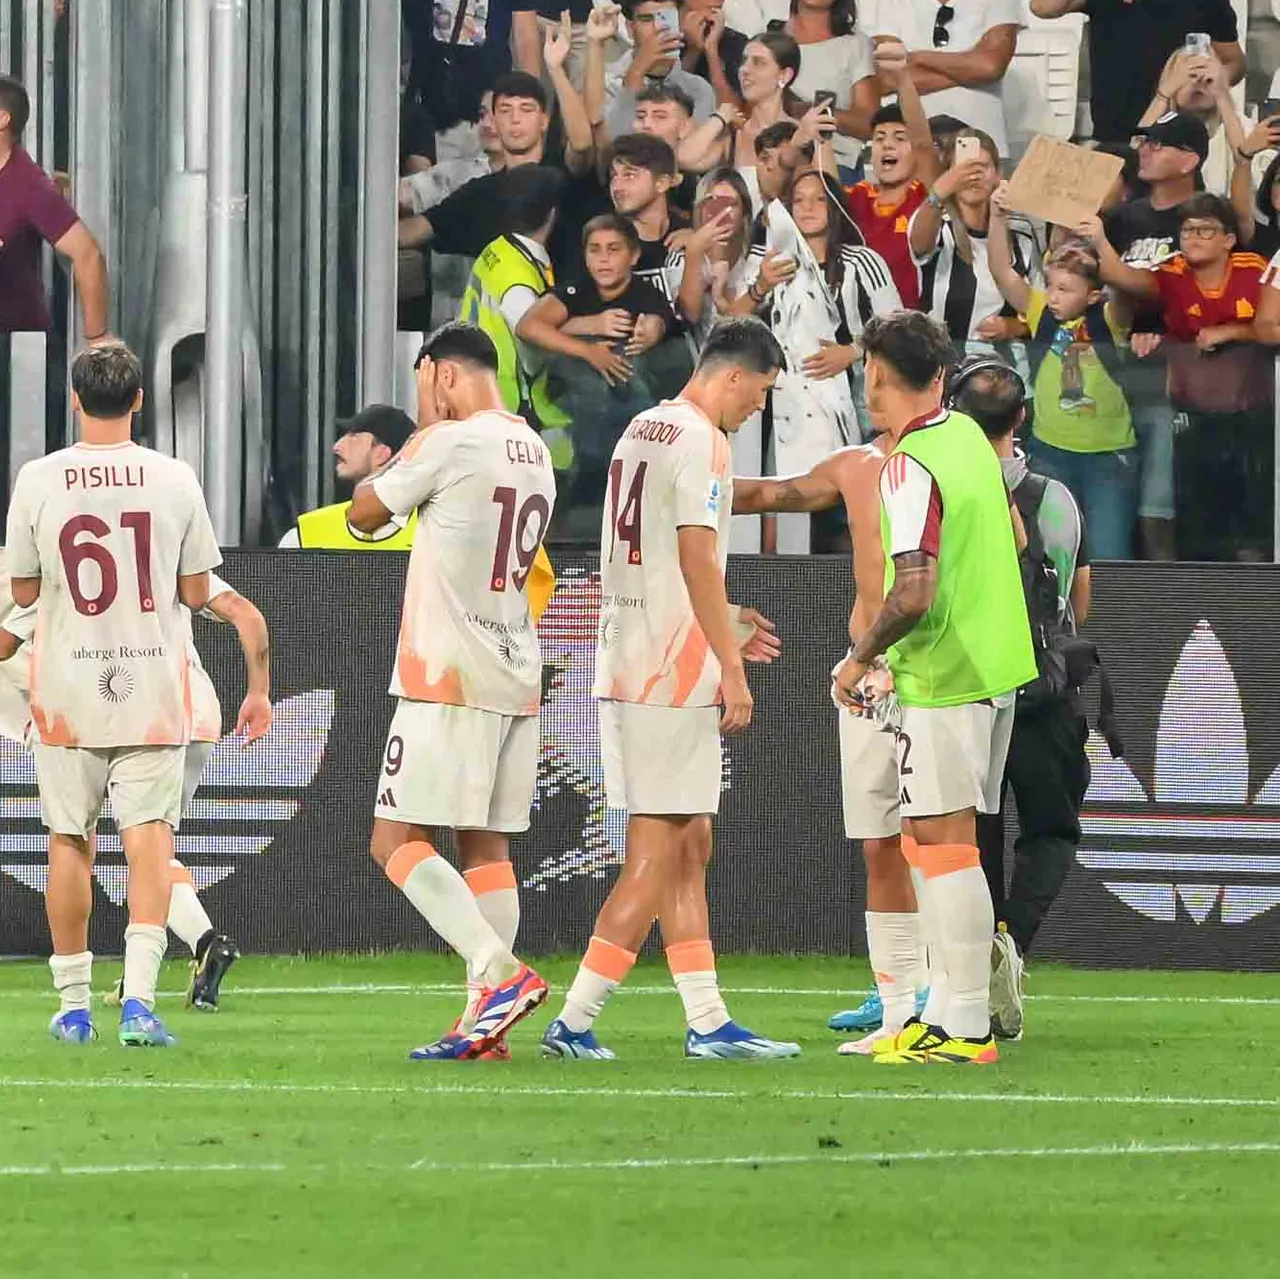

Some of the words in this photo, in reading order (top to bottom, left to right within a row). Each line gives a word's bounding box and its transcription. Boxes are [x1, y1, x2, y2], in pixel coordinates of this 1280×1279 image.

[65, 465, 145, 490] PISILLI
[609, 458, 649, 566] 14
[58, 510, 157, 617] 61
[490, 486, 550, 594] 19
[385, 735, 404, 777] 9
